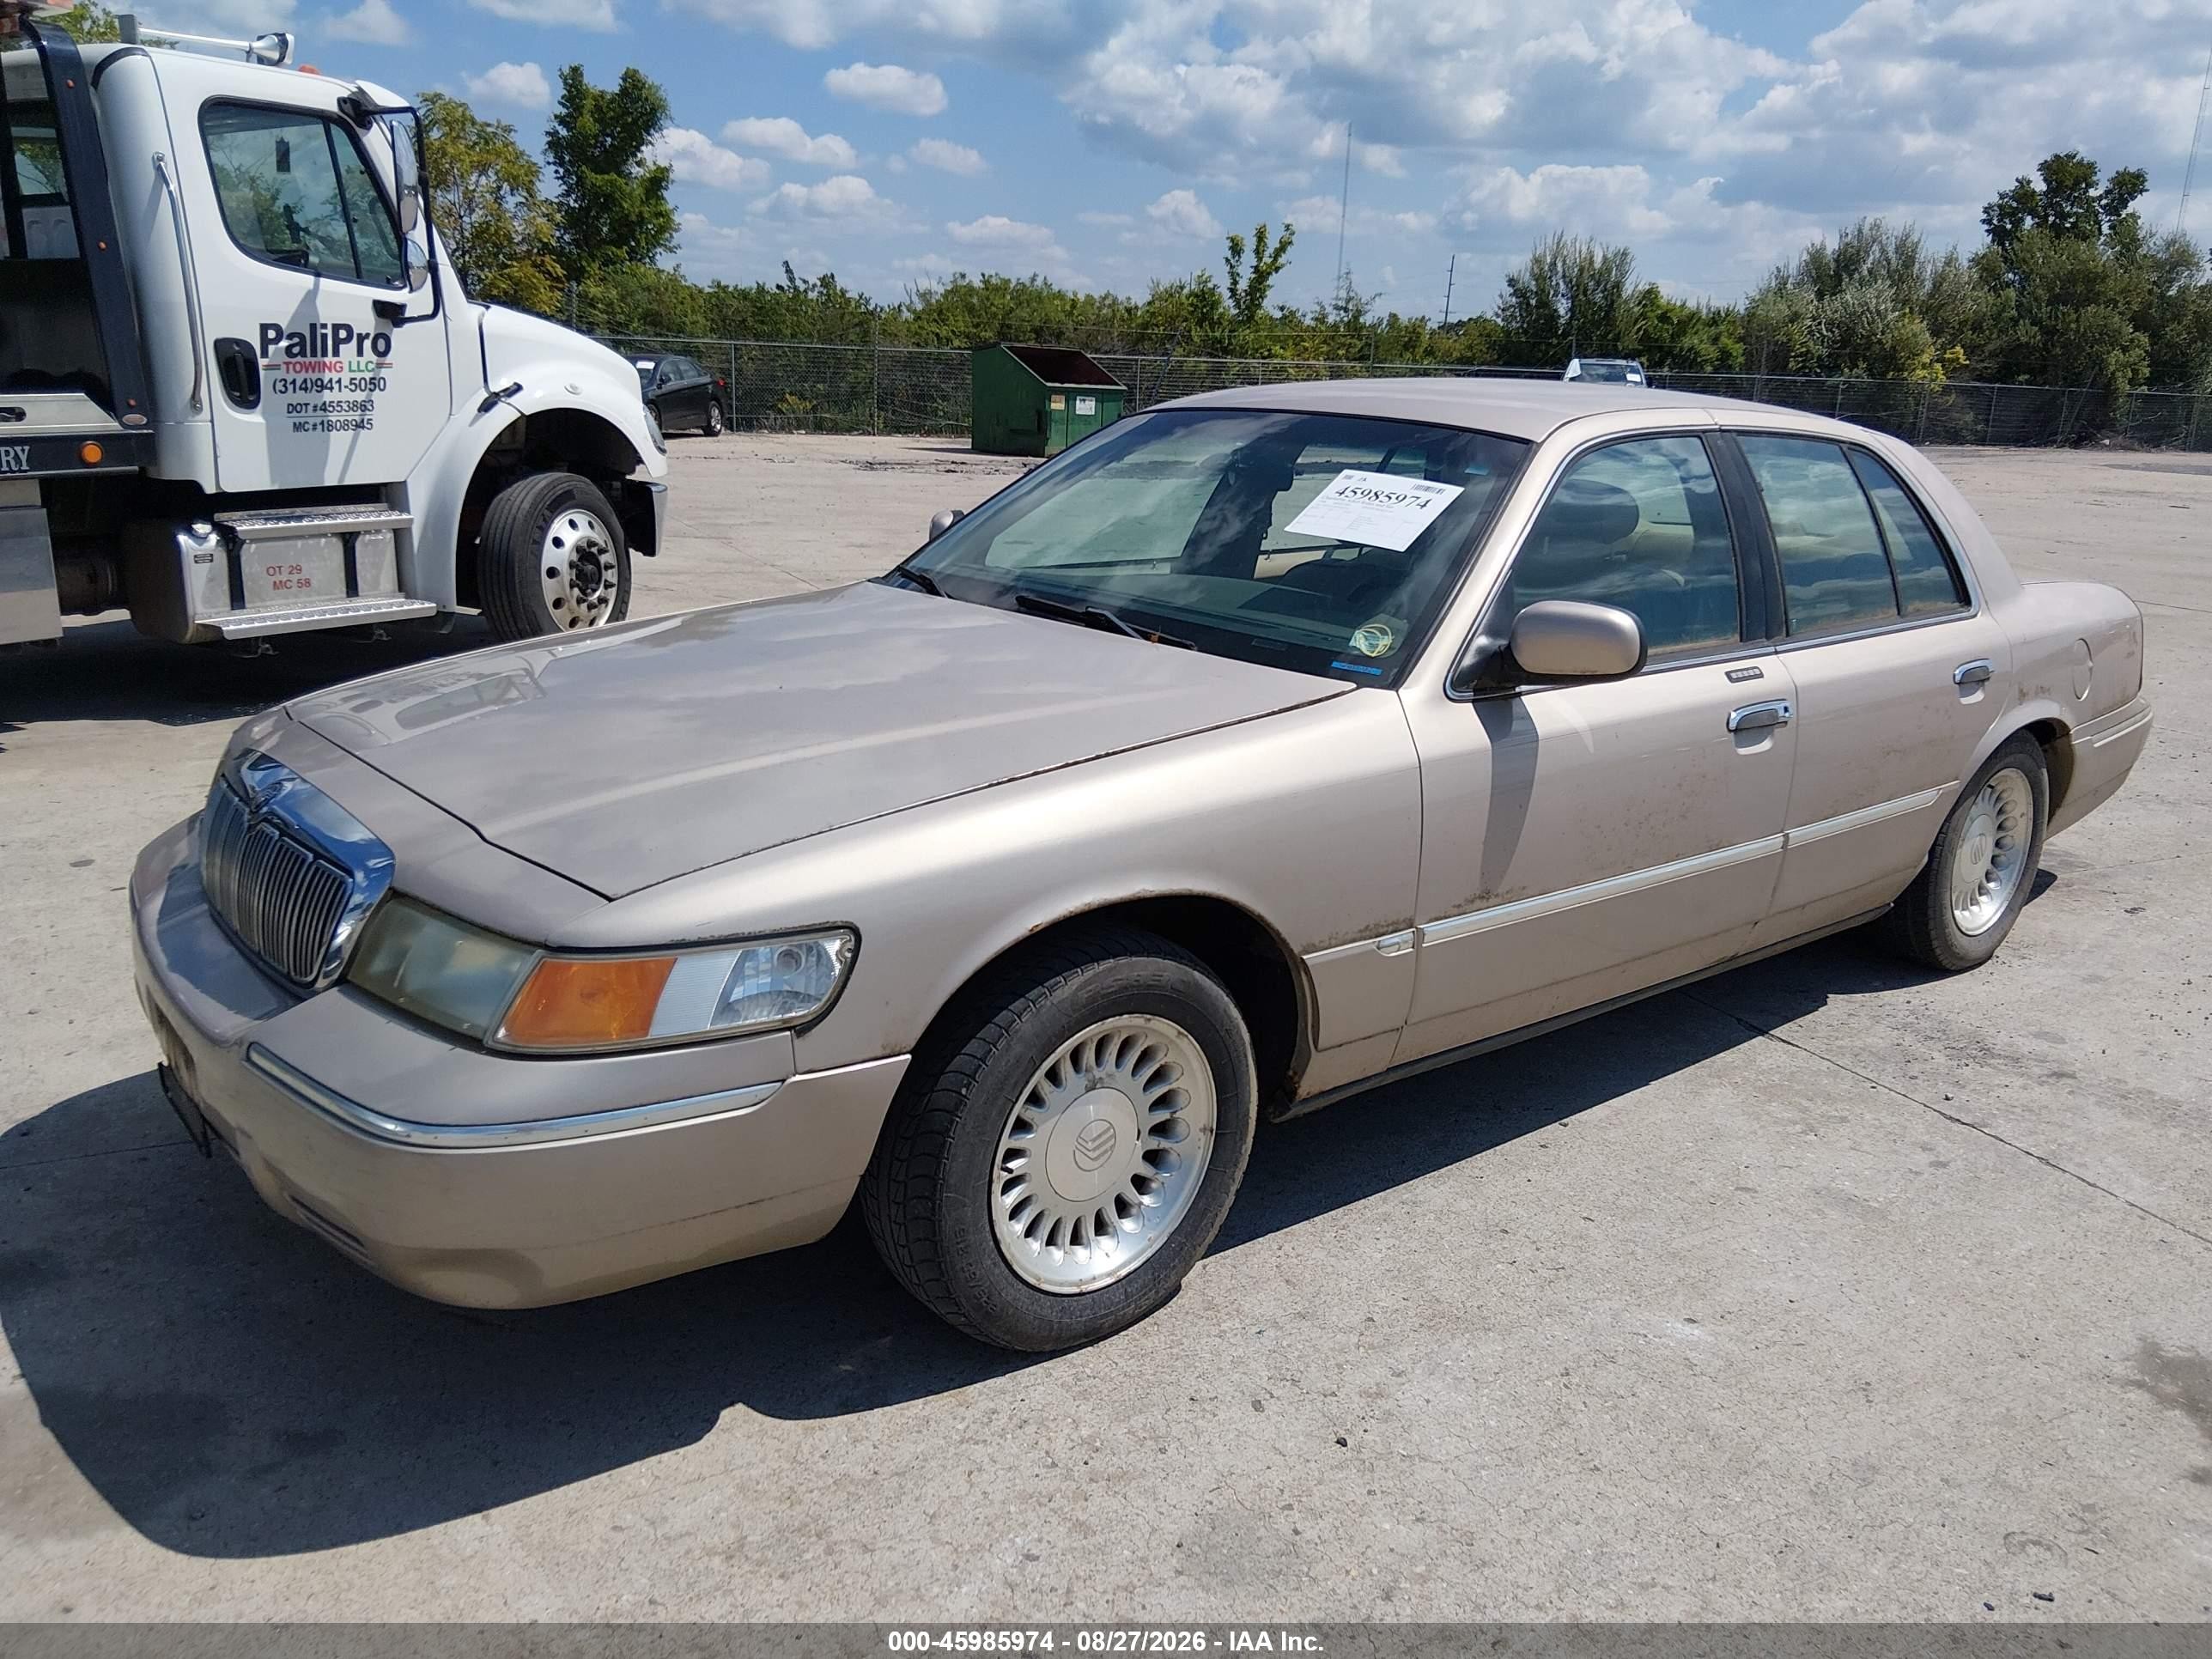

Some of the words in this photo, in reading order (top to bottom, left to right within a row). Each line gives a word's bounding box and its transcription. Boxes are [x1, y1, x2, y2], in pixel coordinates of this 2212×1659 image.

[259, 323, 392, 358] PaliPro
[283, 361, 343, 374] TOWING
[349, 361, 375, 373] LLC
[272, 377, 386, 394] (314)941-5050
[1335, 485, 1432, 510] 45985974
[289, 564, 302, 575] 29
[273, 579, 293, 591] MC
[296, 578, 312, 588] 58
